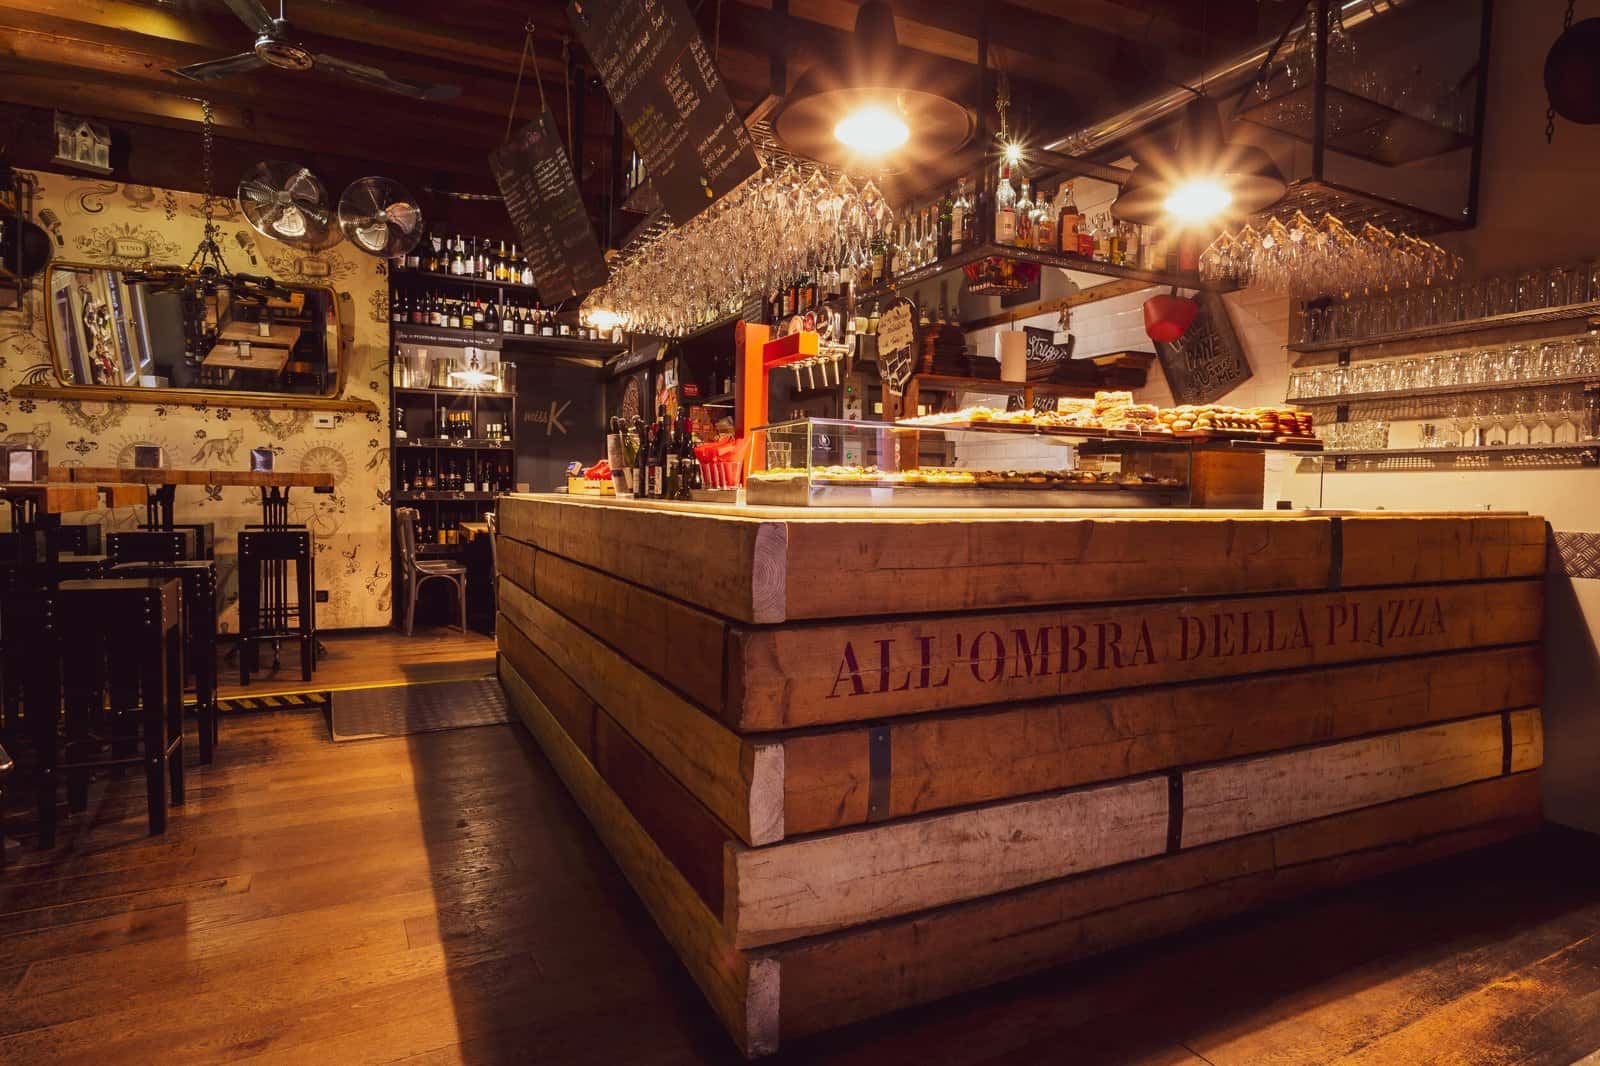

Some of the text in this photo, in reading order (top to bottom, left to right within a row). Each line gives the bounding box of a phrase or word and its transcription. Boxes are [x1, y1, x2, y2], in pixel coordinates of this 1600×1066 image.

[825, 596, 1447, 699] ALL'OMBRA DELLA PIAZZA
